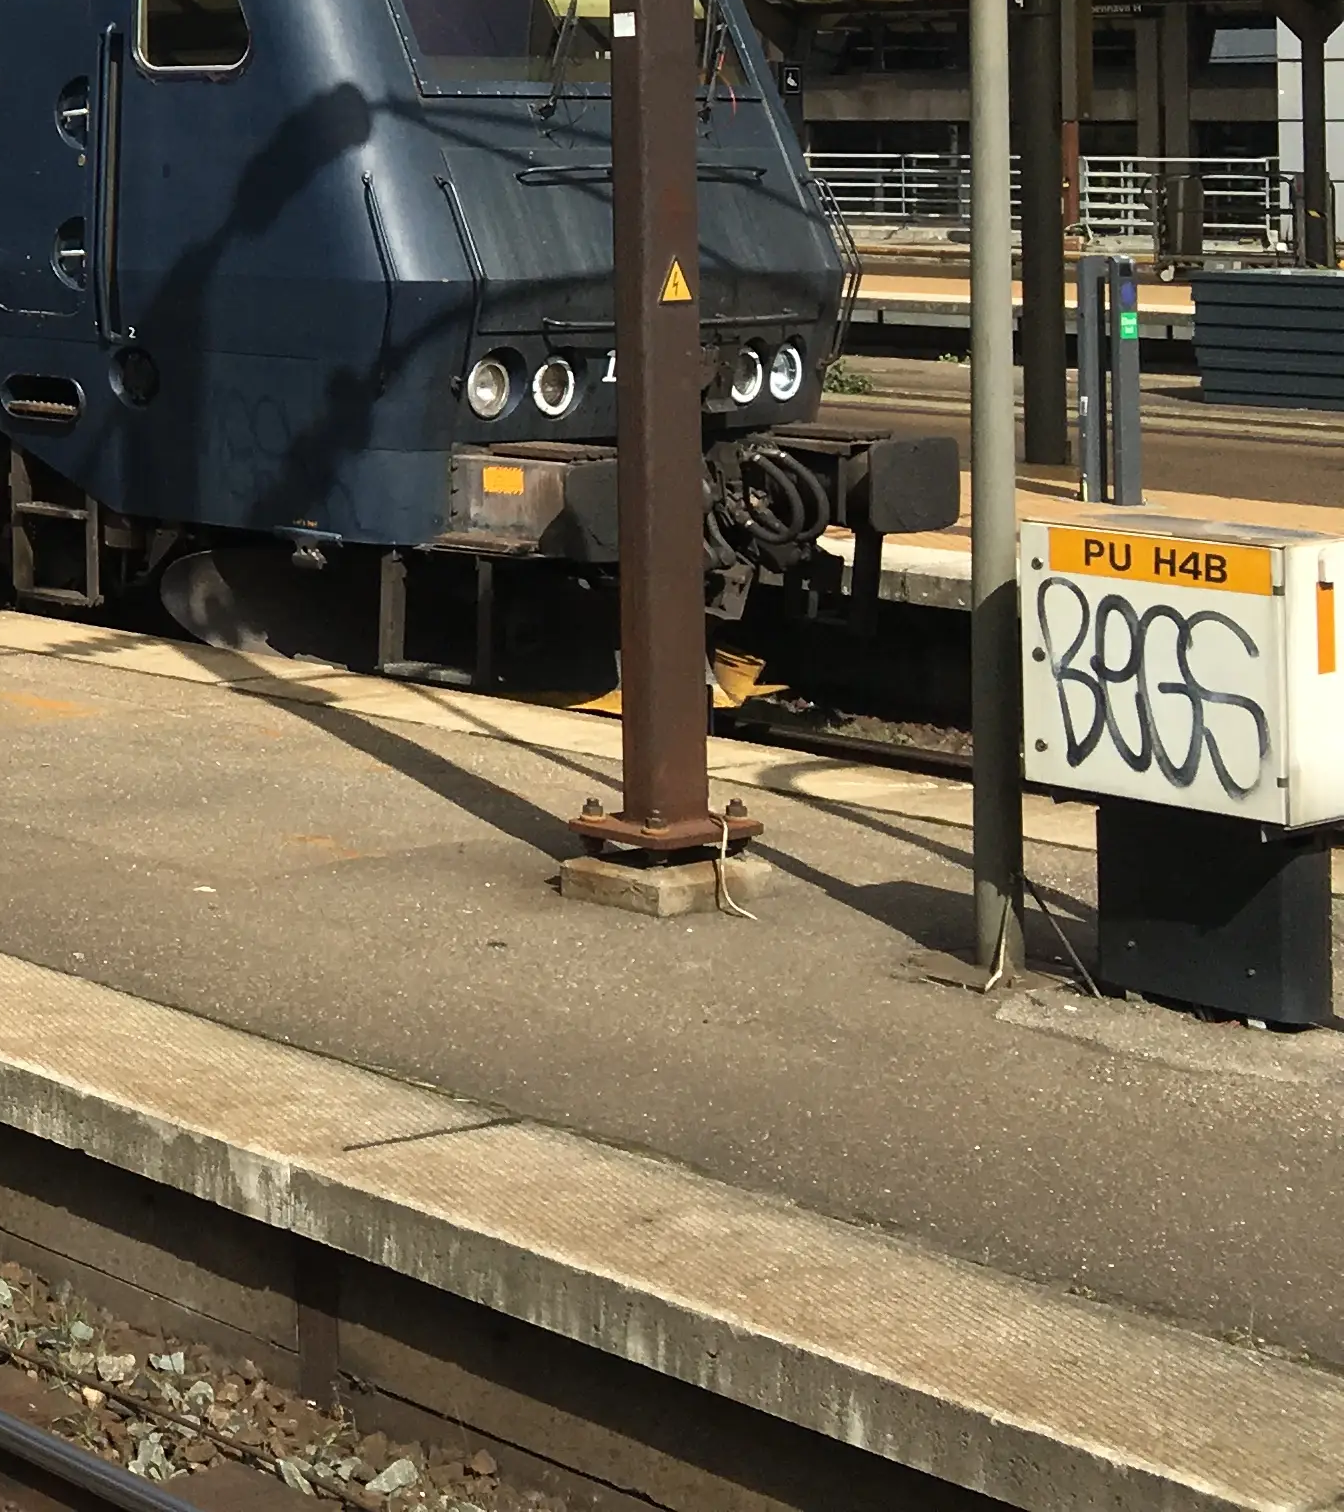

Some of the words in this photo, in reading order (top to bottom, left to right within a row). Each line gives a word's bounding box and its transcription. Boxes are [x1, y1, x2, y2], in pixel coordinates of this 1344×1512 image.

[128, 326, 136, 338] 2
[1084, 538, 1132, 572] PU
[1153, 546, 1228, 584] H4B
